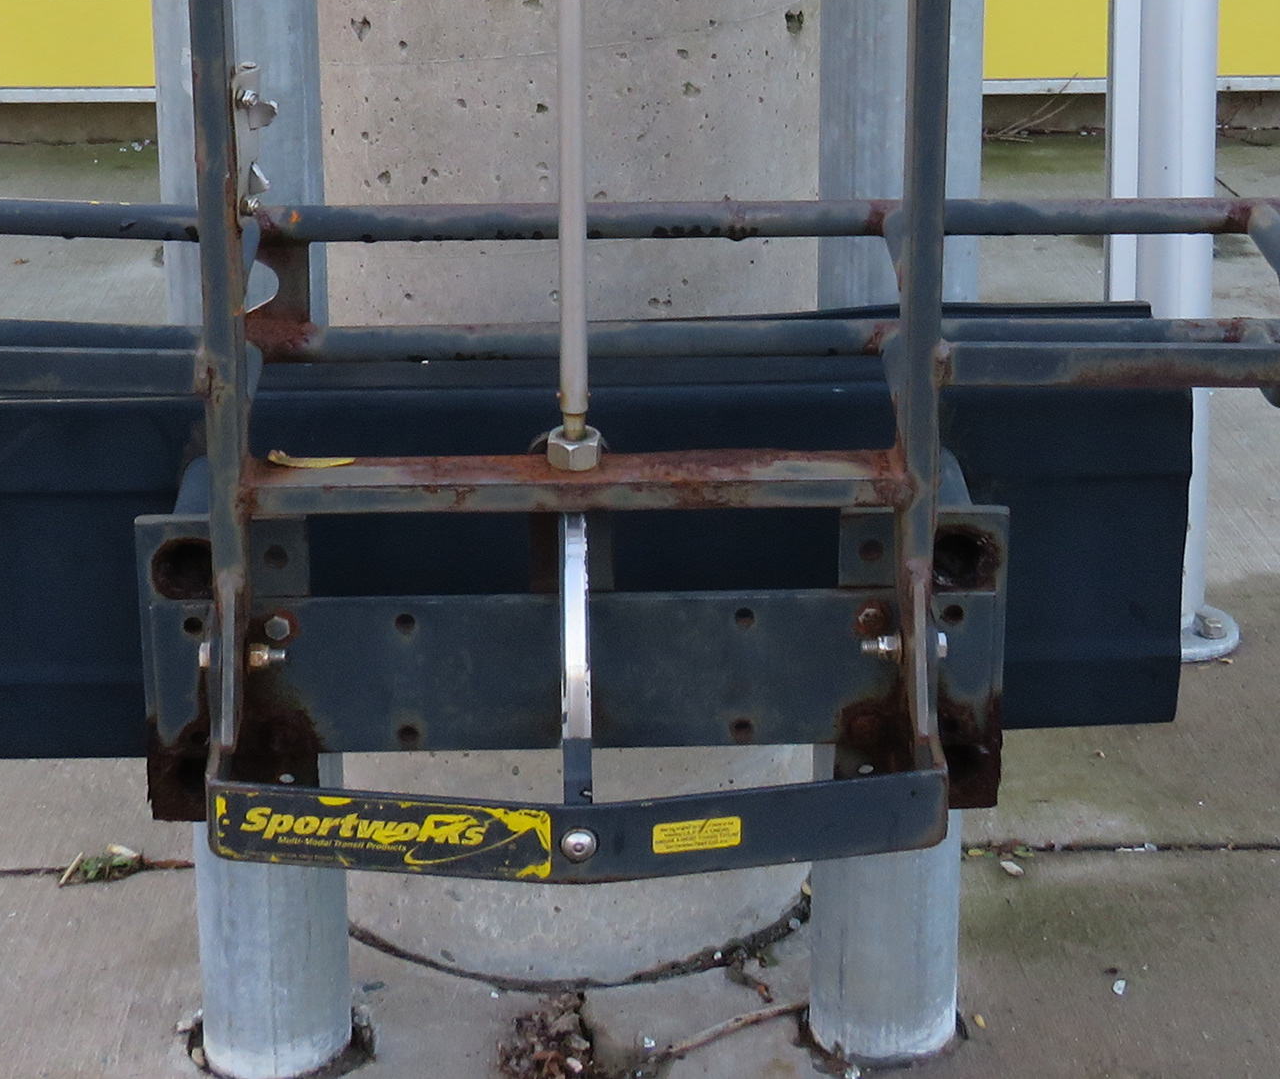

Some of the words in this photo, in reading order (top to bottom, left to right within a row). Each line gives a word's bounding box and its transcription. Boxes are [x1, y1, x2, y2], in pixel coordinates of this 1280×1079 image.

[277, 835, 333, 850] Multi-Modal
[334, 839, 364, 851] Transit
[366, 841, 407, 853] Products
